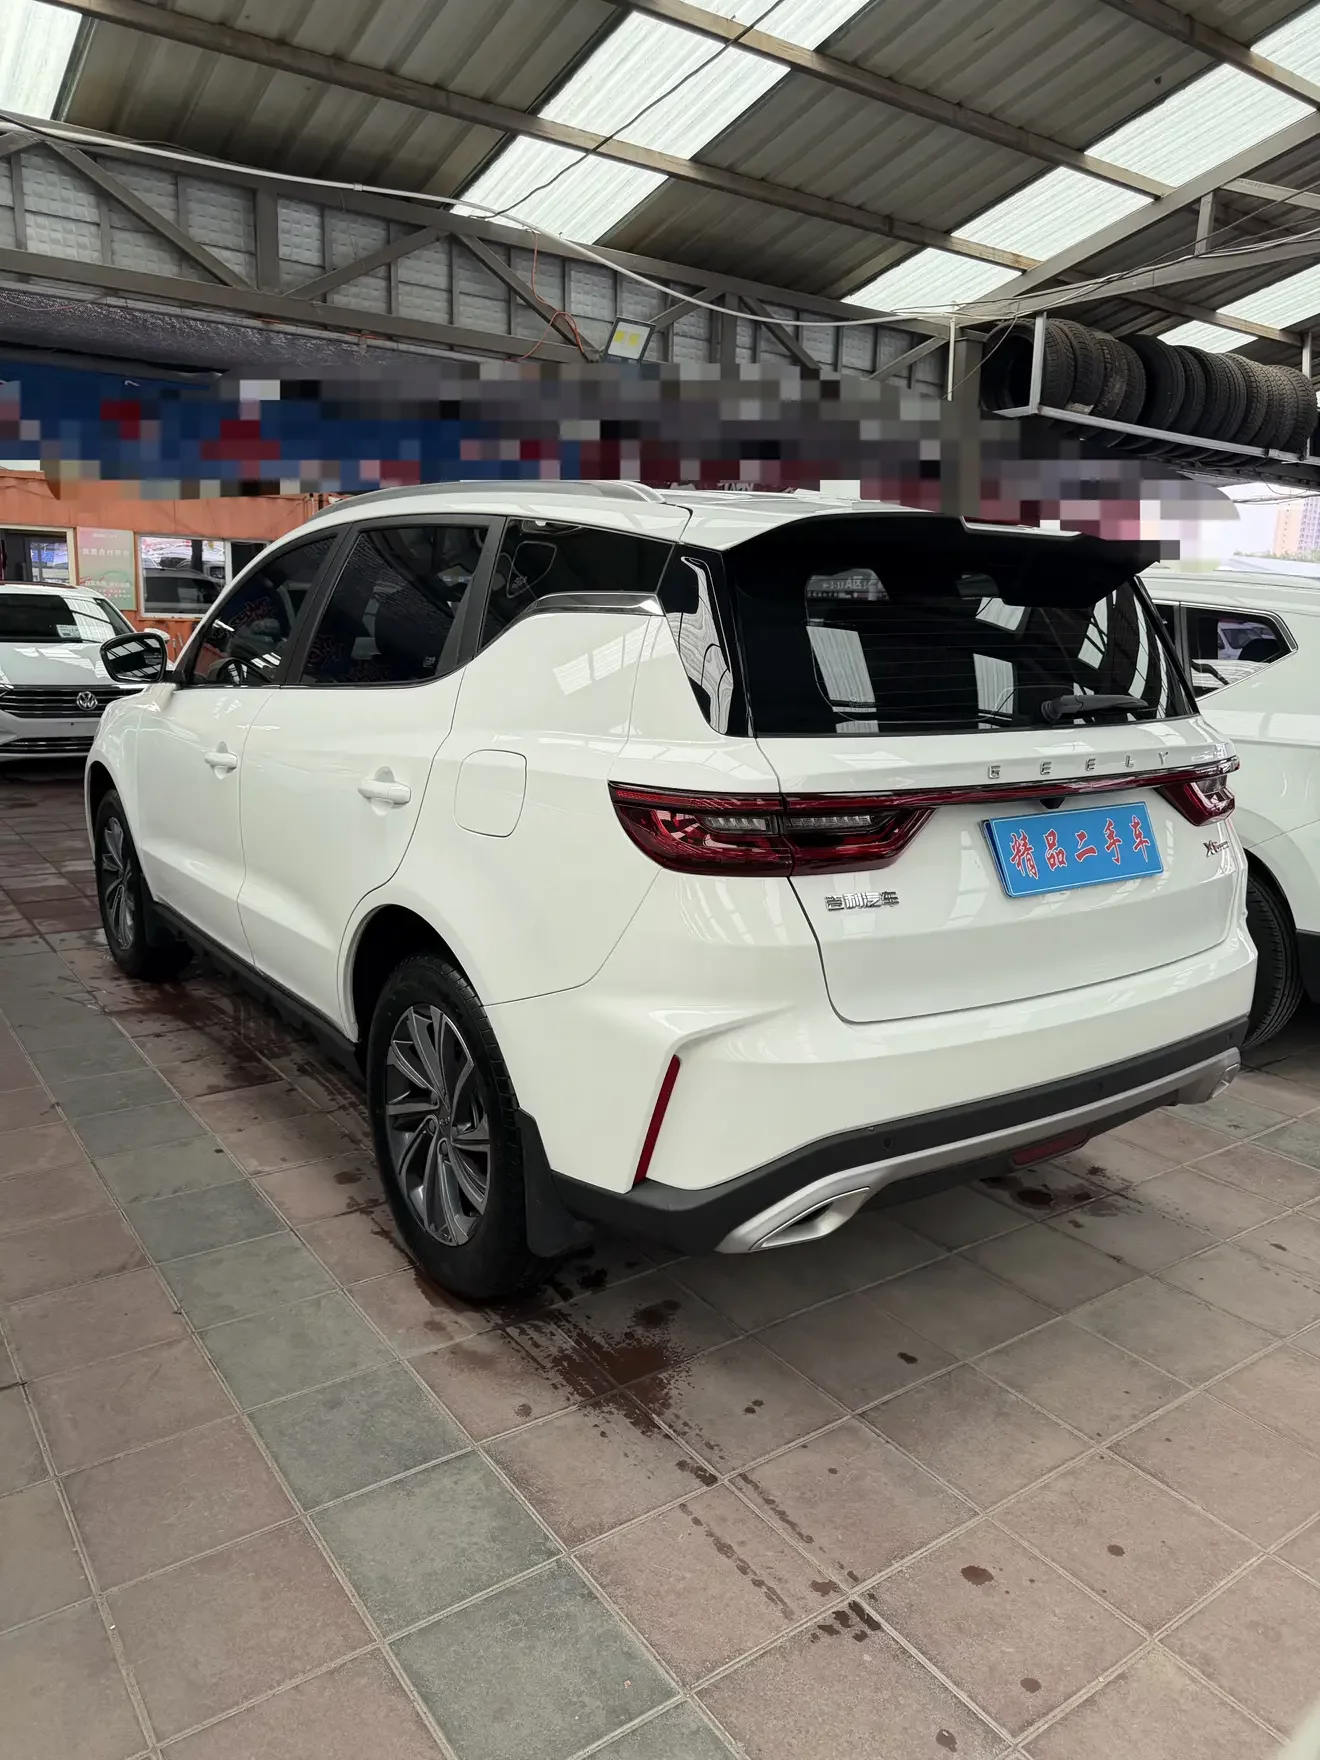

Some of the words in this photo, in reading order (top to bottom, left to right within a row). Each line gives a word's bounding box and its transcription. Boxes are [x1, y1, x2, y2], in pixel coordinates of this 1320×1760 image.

[987, 751, 1168, 779] GEELY
[1009, 814, 1151, 880] 精品二手车
[825, 890, 900, 912] 吉利汽车
